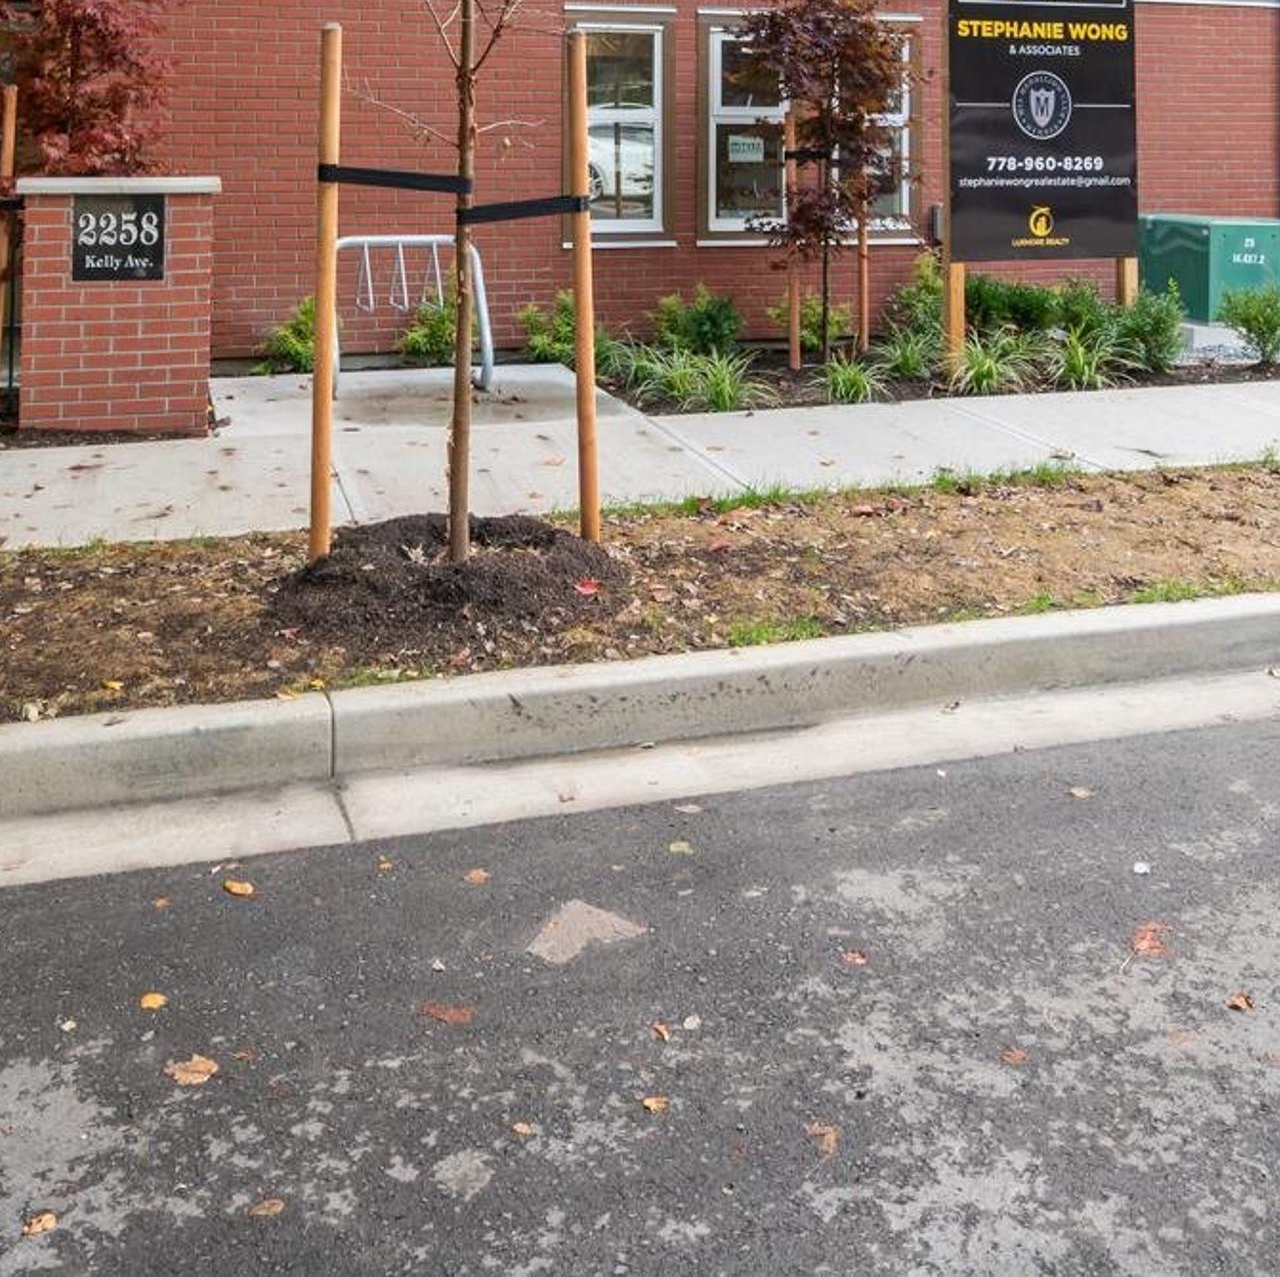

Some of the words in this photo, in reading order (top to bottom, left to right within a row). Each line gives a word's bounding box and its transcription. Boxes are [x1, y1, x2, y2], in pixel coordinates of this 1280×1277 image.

[958, 20, 1064, 39] STEPHANIE
[1068, 22, 1128, 41] WONG
[1009, 45, 1017, 55] &
[1018, 45, 1080, 56] ASSOCIATES
[986, 156, 1104, 171] 778-960-8269
[959, 176, 1131, 189] stephaniewongrealestate@gmail.com
[78, 212, 159, 245] 2258
[85, 255, 122, 271] Kelly
[124, 254, 154, 268] Ave.
